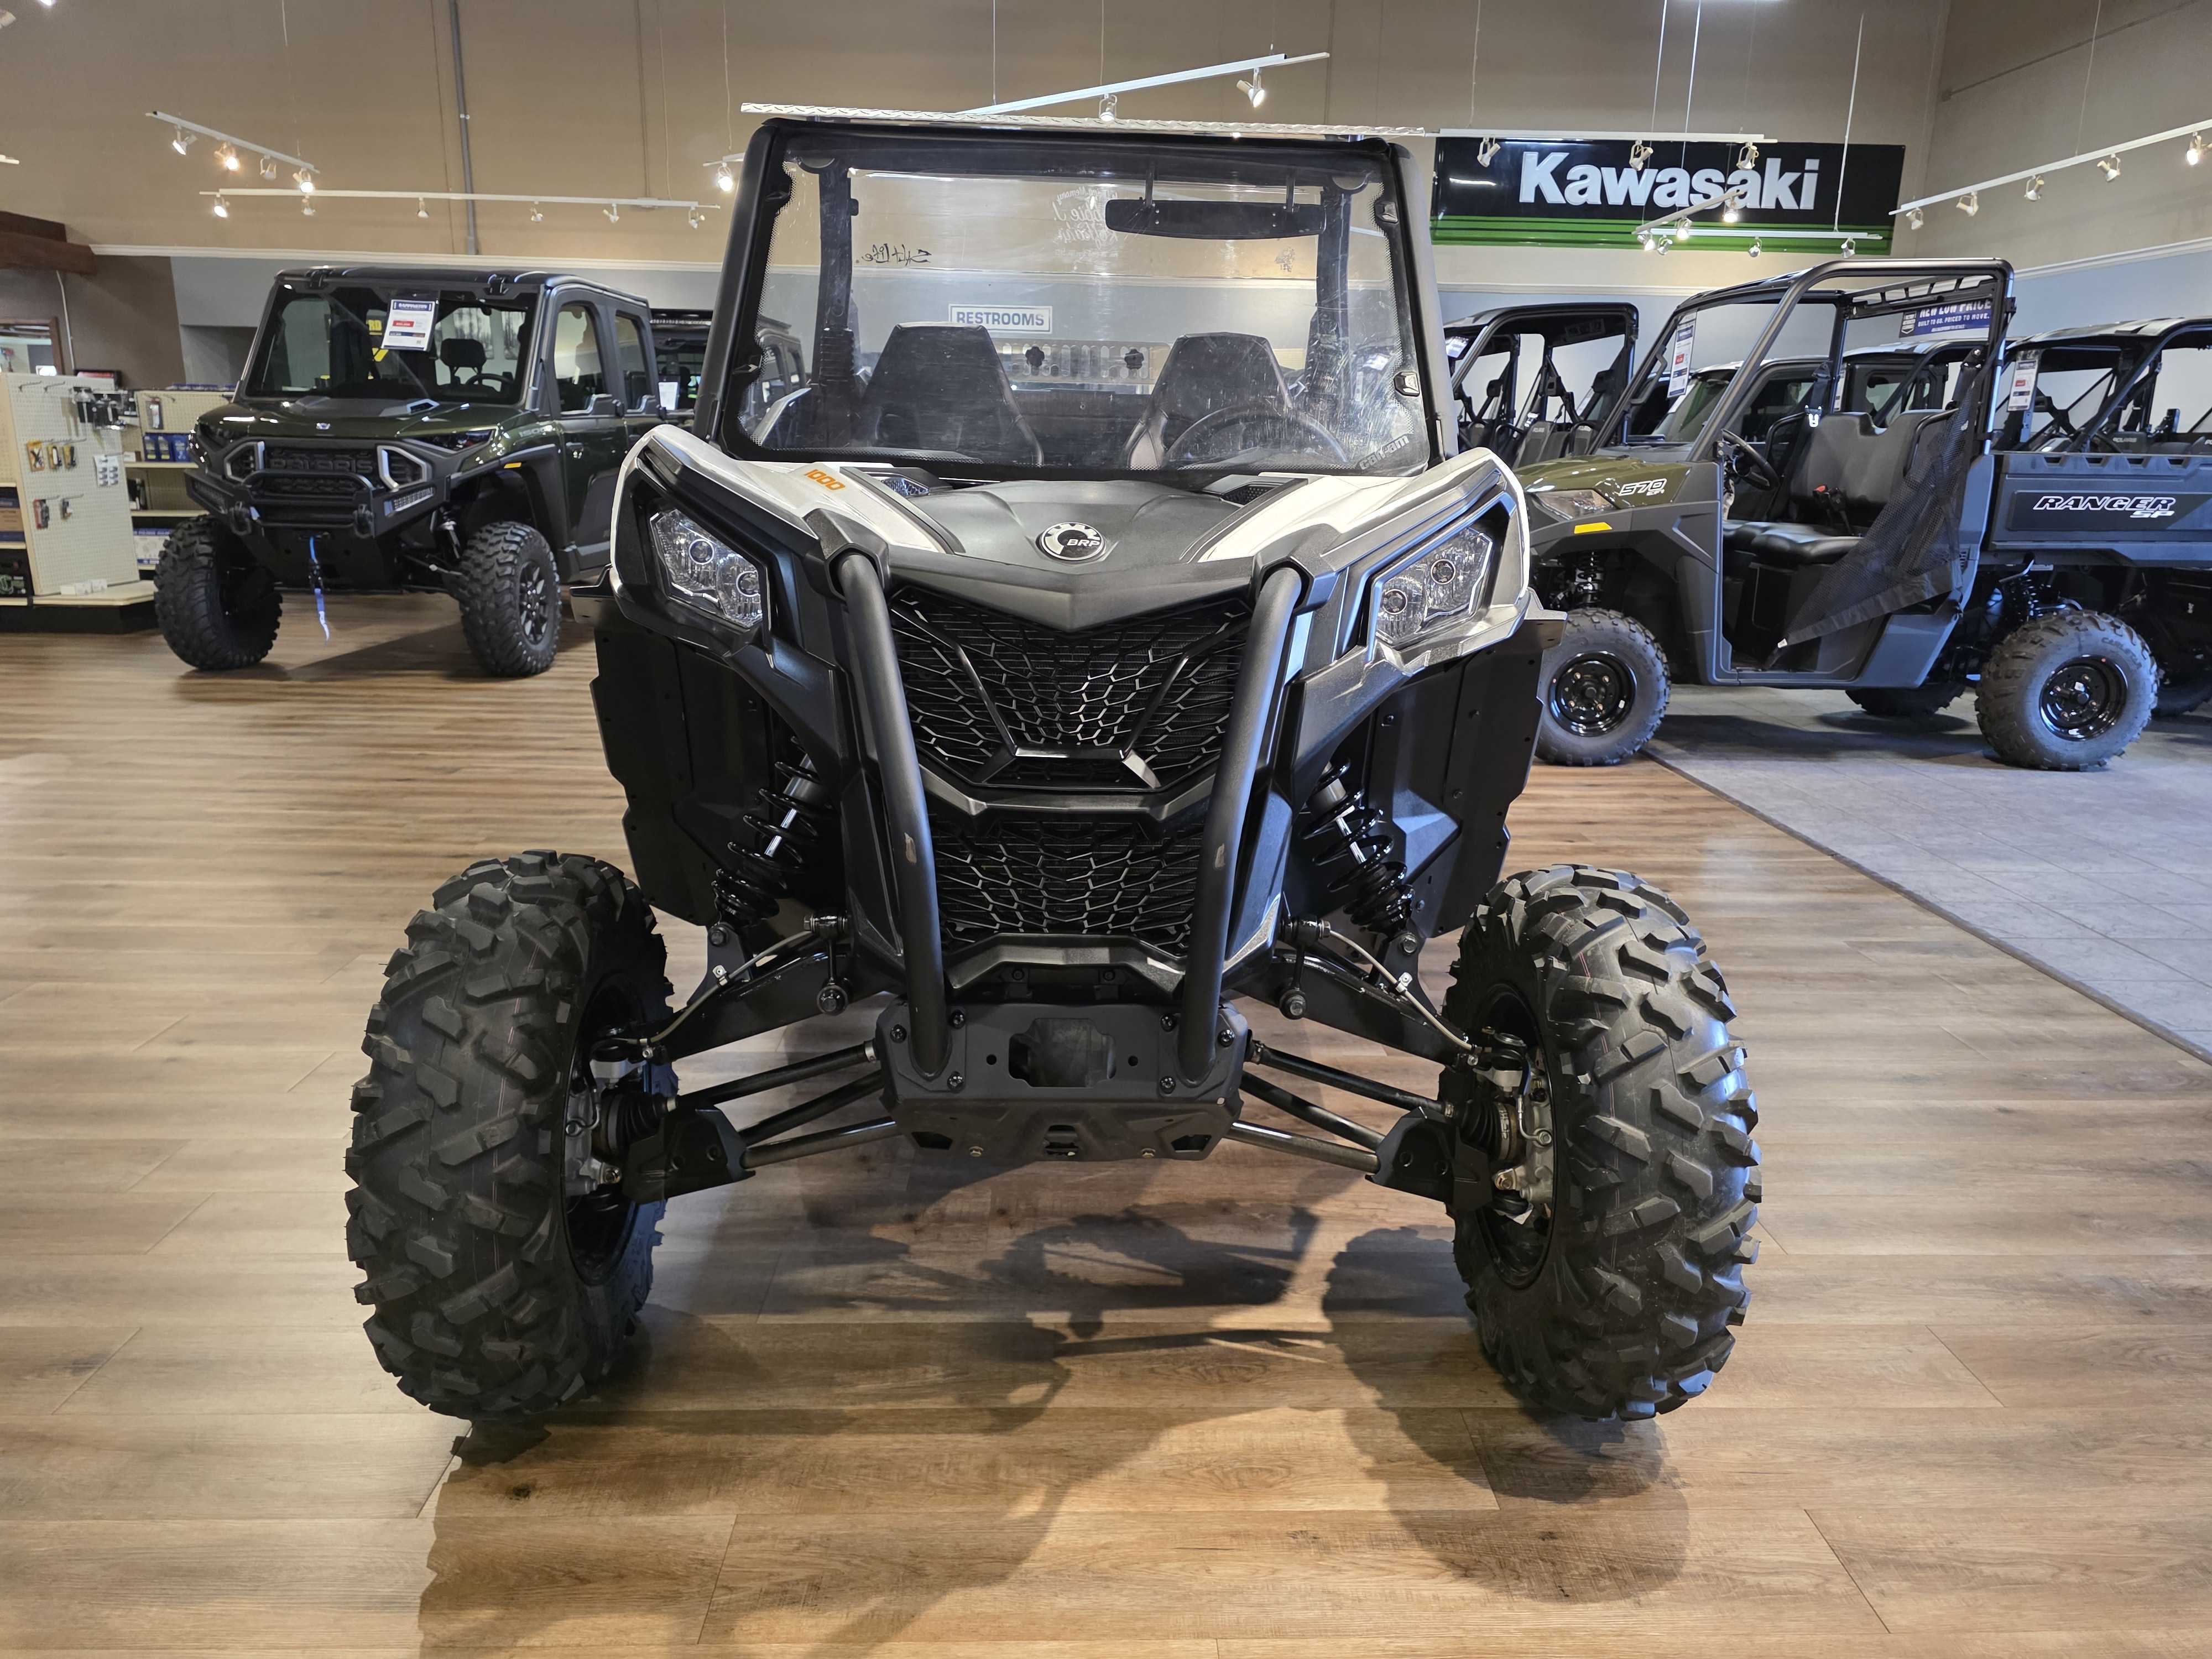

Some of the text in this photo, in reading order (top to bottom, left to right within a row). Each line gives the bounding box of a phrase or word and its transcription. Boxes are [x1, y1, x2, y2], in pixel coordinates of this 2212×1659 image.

[1519, 152, 1819, 210] Kawasaki
[956, 311, 1045, 326] RESTROOMS
[804, 468, 846, 491] 1000
[1618, 478, 1667, 496] 570
[2033, 496, 2176, 510] RANGER
[2130, 510, 2176, 518] SP
[1066, 538, 1100, 547] BRP
